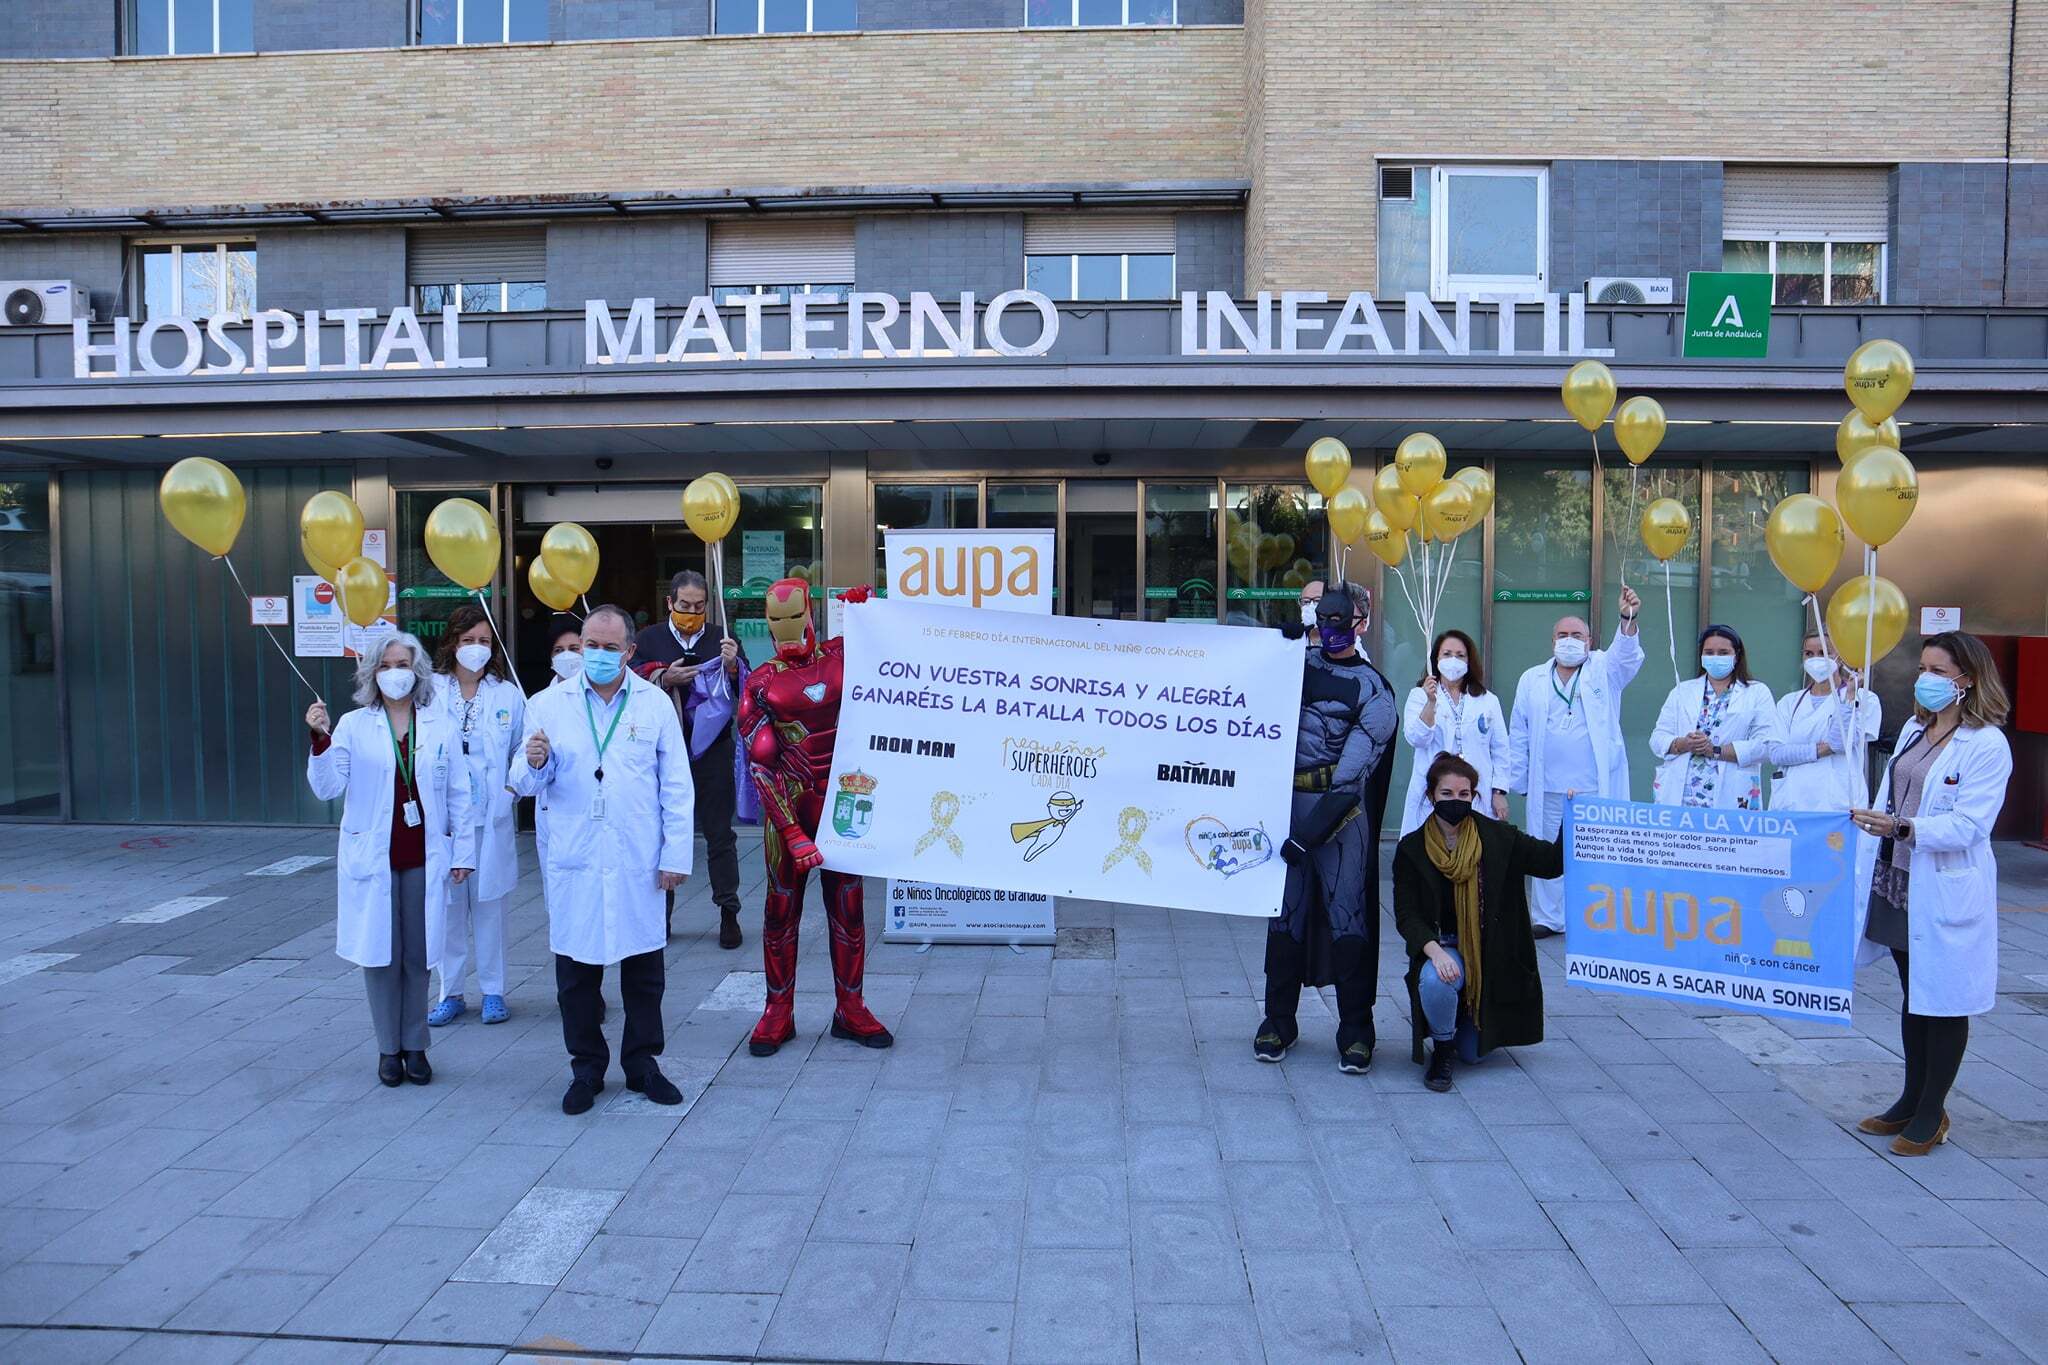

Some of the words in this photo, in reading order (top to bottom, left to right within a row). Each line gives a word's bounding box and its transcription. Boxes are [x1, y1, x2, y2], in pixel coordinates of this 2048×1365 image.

[73, 304, 488, 378] HOSPITAL
[585, 288, 1059, 364] MATERNO
[1181, 290, 1615, 357] INFANTIL
[1691, 329, 1713, 338] Junta
[1714, 329, 1724, 338] de
[1725, 329, 1762, 338] Andalucía
[899, 545, 1038, 608] aupa
[407, 620, 447, 637] ENTR
[735, 621, 767, 637] ENT
[922, 627, 932, 636] 15
[934, 628, 945, 637] DE
[948, 629, 989, 641] FEBRERO
[1011, 634, 1091, 650] INTERNACIONAL
[1094, 642, 1112, 651] DEL
[1144, 646, 1166, 656] CON
[1168, 645, 1205, 658] CÁNCER
[878, 660, 921, 680] CON
[930, 665, 1021, 688] VUESTRA
[1030, 675, 1126, 698] SONRISA
[1136, 683, 1149, 700] Y
[1157, 684, 1246, 708] ALEGRÍA
[852, 684, 954, 710] GANARÉIS
[962, 696, 986, 714] LA
[996, 701, 1085, 722] BATALLA
[1095, 708, 1168, 730] TODOS
[1176, 715, 1218, 735] LOS
[1227, 715, 1282, 740] DÍAS
[869, 734, 913, 755] IRON
[917, 739, 956, 758] MAN
[1011, 749, 1097, 779] SUPERHÉROES
[1157, 761, 1235, 788] BATMAN
[1572, 802, 1672, 826] SONRÍELE
[1679, 814, 1695, 829] A
[1703, 813, 1731, 832] LA
[1738, 815, 1799, 836] VIDA
[1232, 839, 1252, 854] aupa
[1575, 825, 1585, 833] La
[1588, 827, 1629, 836] esperanza
[1653, 832, 1677, 840] mejor
[1705, 836, 1727, 844] para
[1729, 836, 1759, 846] pintar
[1575, 834, 1610, 843] nuestros
[1575, 842, 1604, 851] Aunque
[1617, 846, 1635, 854] vida
[1648, 849, 1675, 858] golpee
[1575, 851, 1605, 860] Aunque
[1620, 855, 1643, 864] todos
[1647, 857, 1659, 865] los
[1662, 860, 1713, 870] amaneceres
[1716, 864, 1737, 872] sean
[1740, 865, 1789, 876] hermosos.
[893, 887, 904, 900] de
[907, 886, 932, 901] Niños
[935, 887, 991, 904] Oncológicos
[994, 889, 1006, 901] de
[1583, 883, 1743, 951] aupa
[1759, 957, 1780, 969] con
[1782, 955, 1820, 973] cáncer
[1569, 959, 1651, 985] AYÚDANOS
[1656, 972, 1668, 987] A
[1673, 975, 1726, 996] SACAR
[1732, 983, 1766, 1003] UNA
[1772, 988, 1851, 1014] SONRISA
